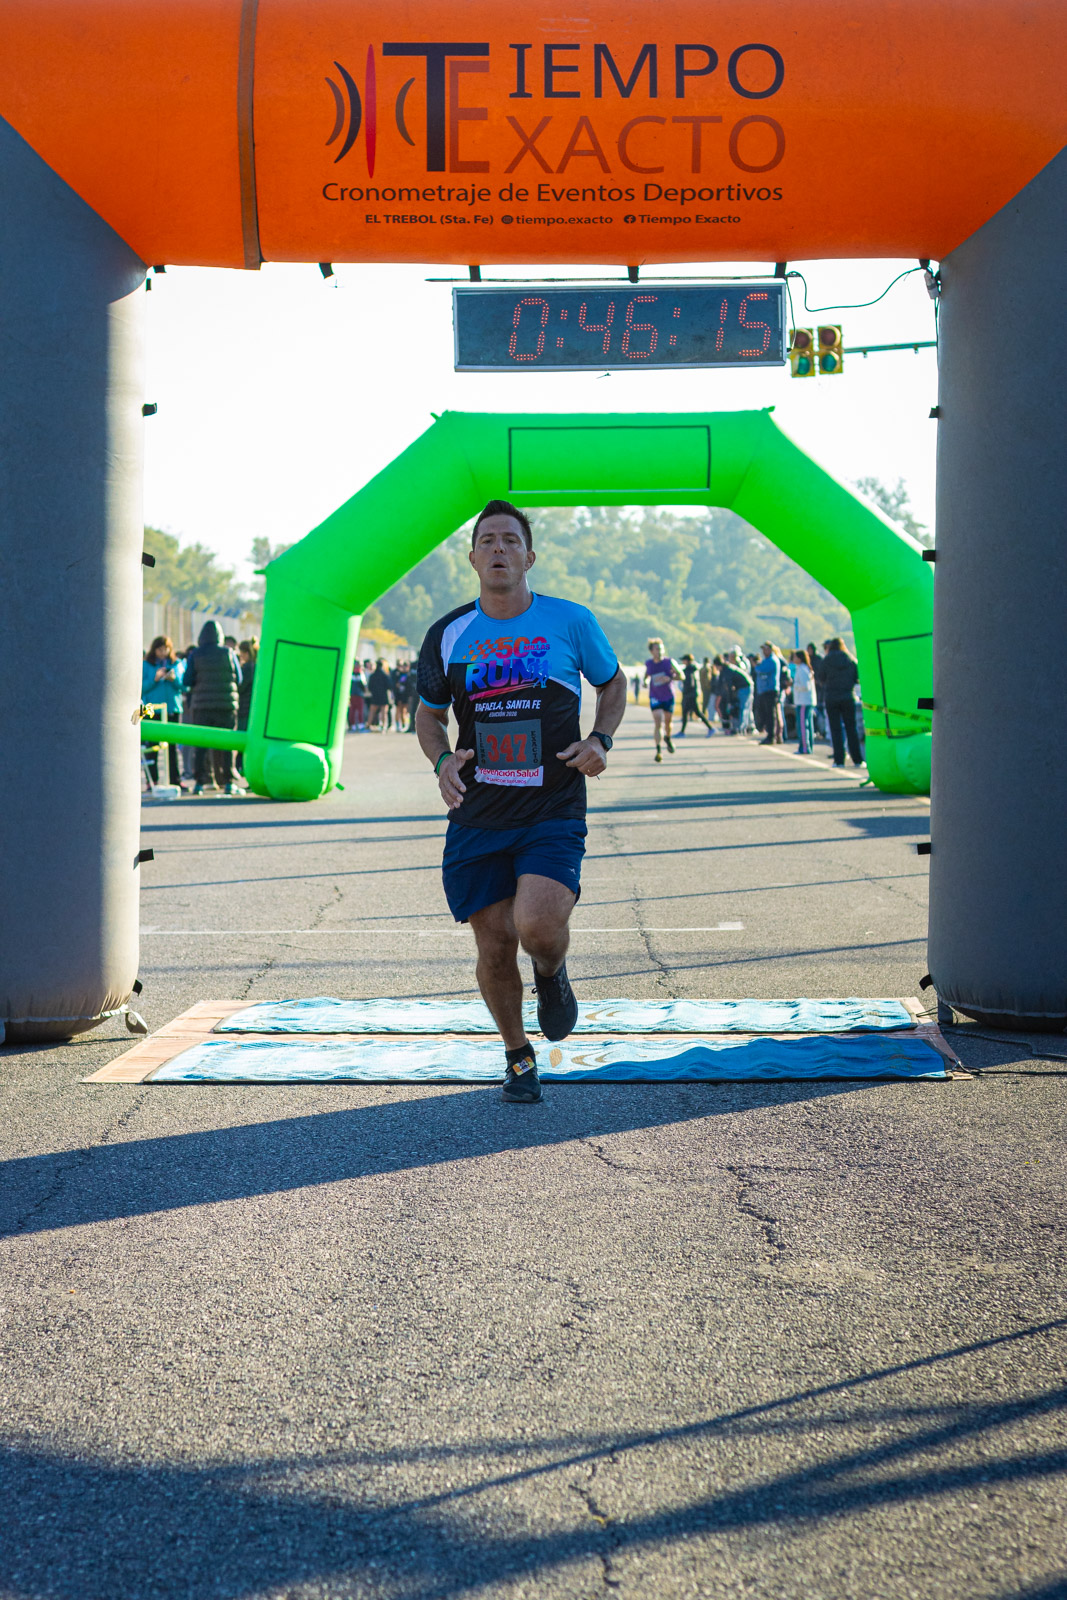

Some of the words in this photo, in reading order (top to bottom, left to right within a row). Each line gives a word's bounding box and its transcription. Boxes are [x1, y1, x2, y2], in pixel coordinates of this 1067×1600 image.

[322, 182, 491, 206] Cronometraje
[498, 183, 529, 202] de
[537, 183, 635, 202] Eventos
[644, 182, 783, 206] Deportivos
[365, 214, 381, 224] EL
[383, 214, 437, 224] TREBOL
[440, 214, 471, 225] (Sta.
[474, 214, 494, 225] Fe)
[516, 214, 613, 226] tiempo.exacto
[638, 214, 692, 226] Tiempo
[695, 214, 741, 224] Exacto
[506, 699, 530, 710] SANTA
[531, 699, 541, 710] FE
[486, 733, 527, 763] 347
[478, 768, 515, 777] revención
[516, 768, 539, 778] Salud
